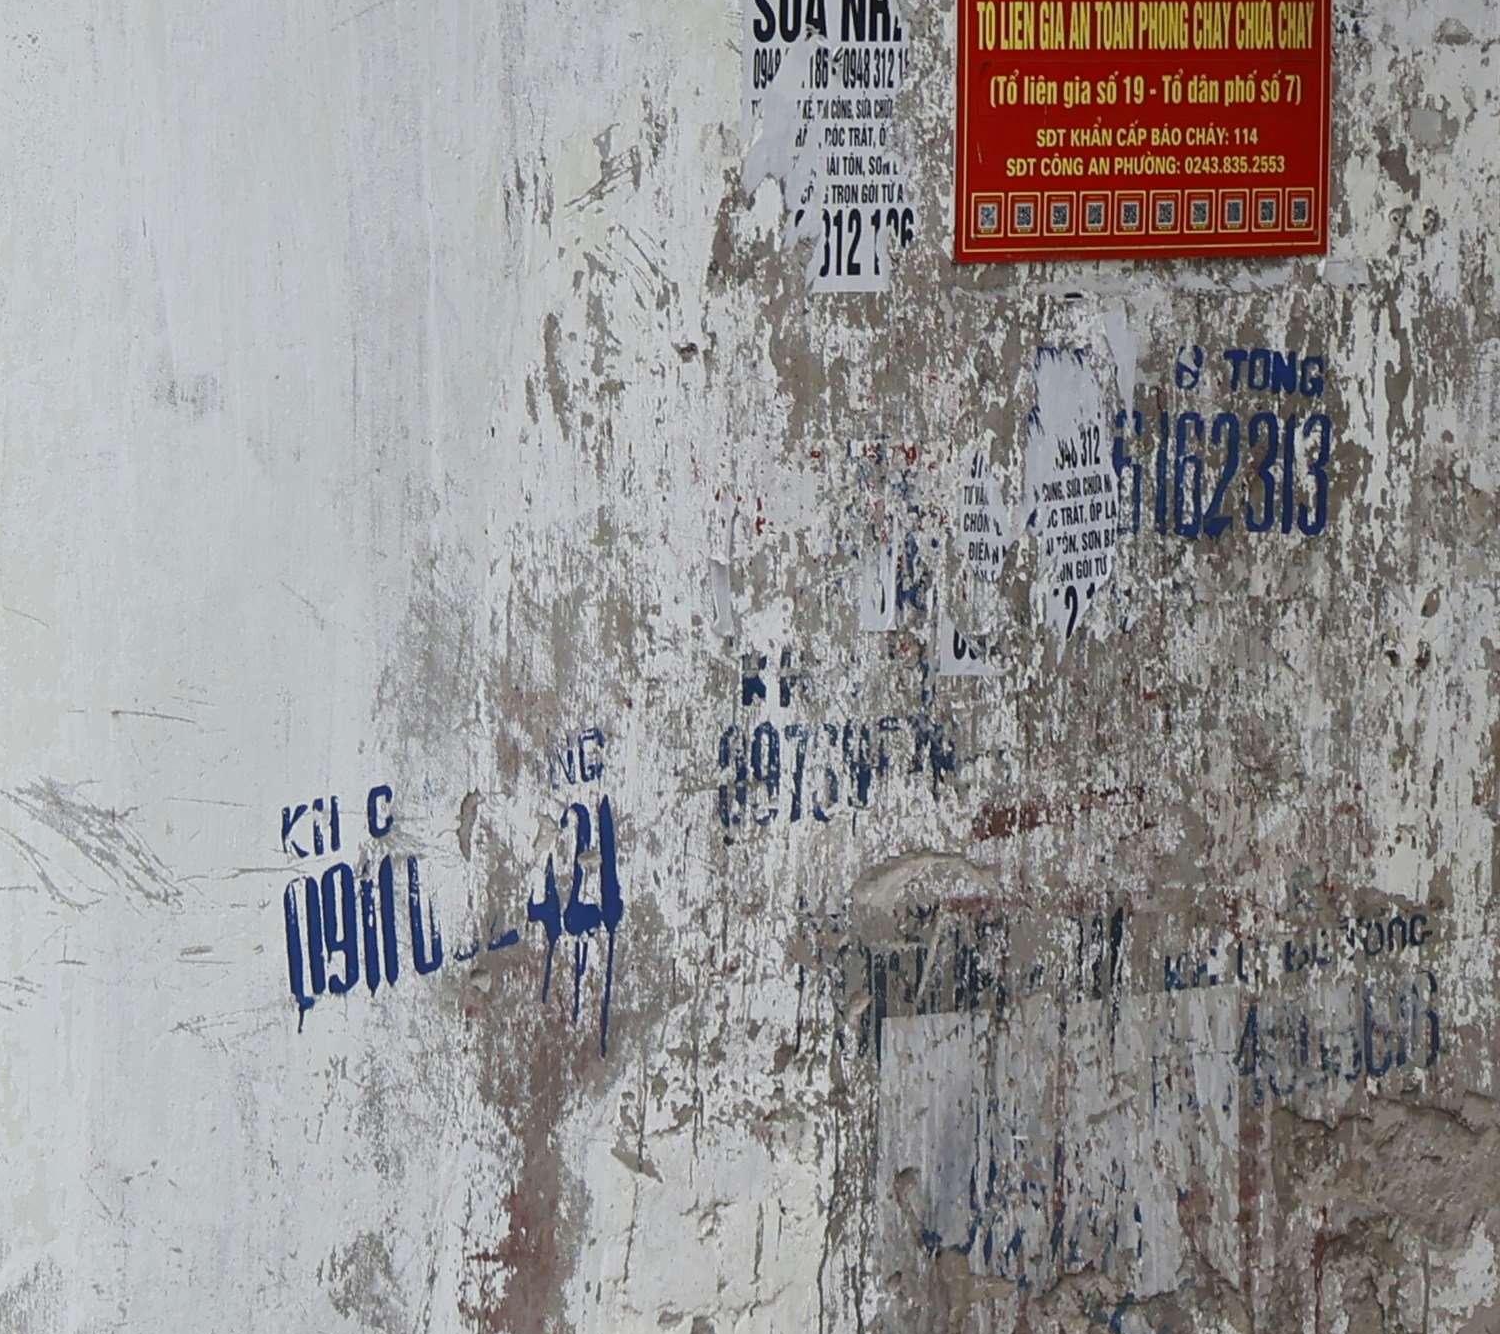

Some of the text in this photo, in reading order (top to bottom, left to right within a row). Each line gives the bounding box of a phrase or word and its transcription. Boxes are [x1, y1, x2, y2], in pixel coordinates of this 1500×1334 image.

[1039, 1, 1065, 51] GIA
[1069, 1, 1091, 50] AN
[990, 69, 1020, 108] (Tổ
[1024, 75, 1057, 105] liên
[1063, 75, 1091, 108] gia
[1097, 70, 1119, 105] số
[1123, 75, 1145, 105] 19
[1162, 68, 1184, 104] Tổ
[1188, 74, 1219, 104] dân
[1224, 70, 1257, 107] phố
[1261, 70, 1281, 103] số
[1285, 74, 1302, 105] 7)
[1036, 116, 1258, 147] SĐT KHẨN CẤP BÁO CHÁY: 114
[1006, 151, 1285, 177] SĐT CÔNG AN PHƯỜNG: 0243.835.2553
